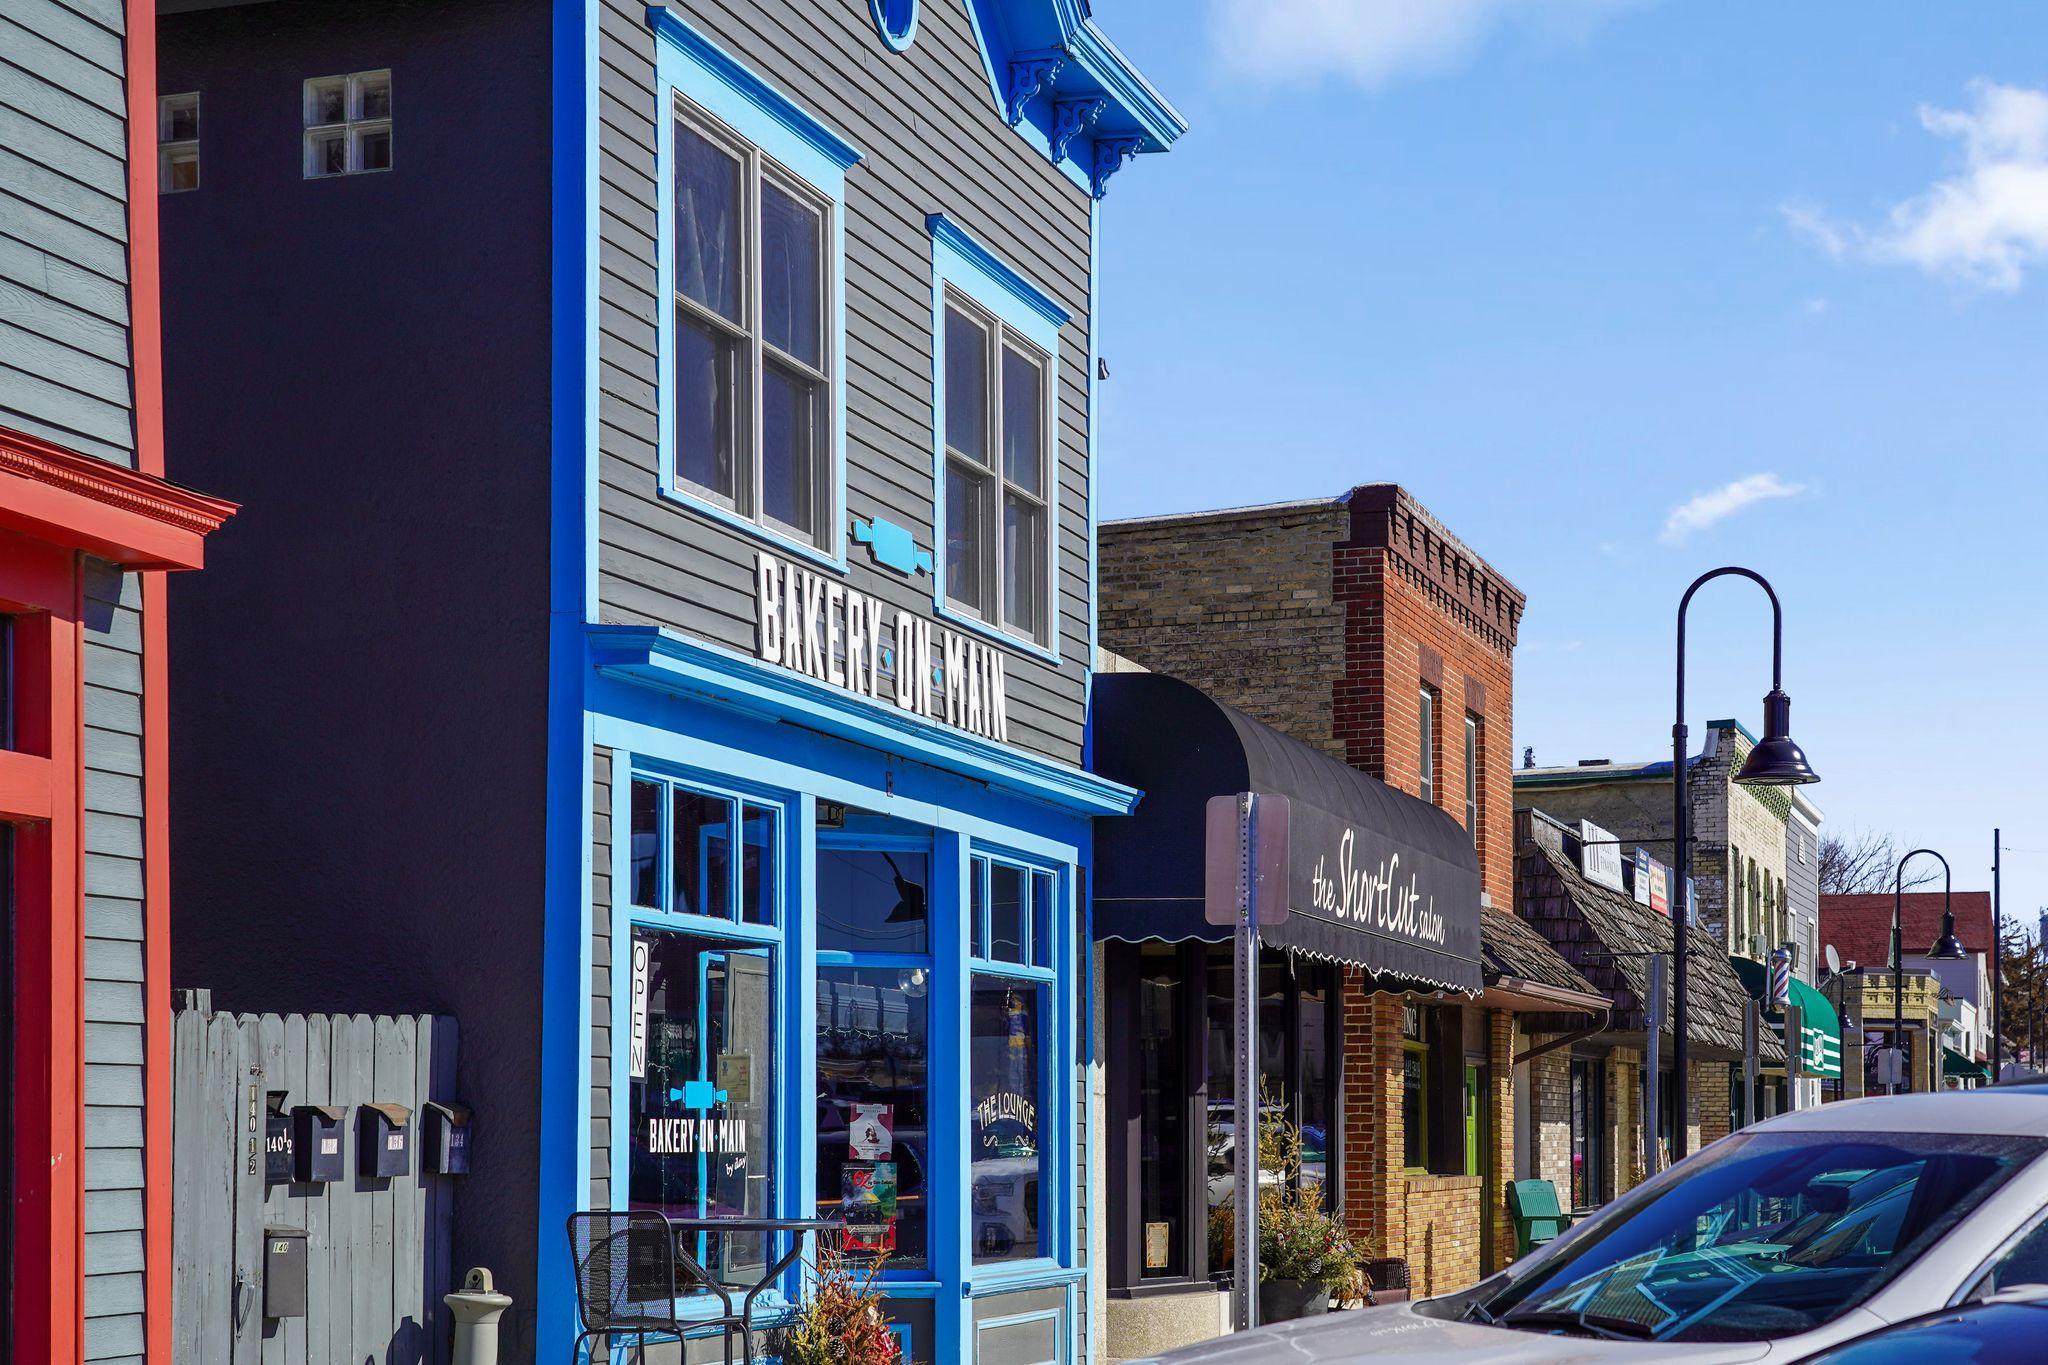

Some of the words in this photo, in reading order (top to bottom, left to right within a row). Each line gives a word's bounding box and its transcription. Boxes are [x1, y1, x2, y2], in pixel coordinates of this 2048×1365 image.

[758, 551, 883, 699] BAKERY
[896, 611, 932, 718] ON
[944, 630, 1008, 742] MAIN
[1313, 854, 1336, 911] the
[1419, 896, 1445, 946] salon
[632, 945, 646, 1073] OPEN
[1402, 1006, 1418, 1036] ING
[977, 1095, 997, 1130] THE
[998, 1092, 1034, 1132] LOUNGE
[650, 1119, 694, 1153] BAKERY
[700, 1120, 714, 1152] ON
[719, 1120, 746, 1152] MAIN
[725, 1163, 733, 1177] by
[734, 1156, 747, 1170] day
[274, 1242, 288, 1252] 140
